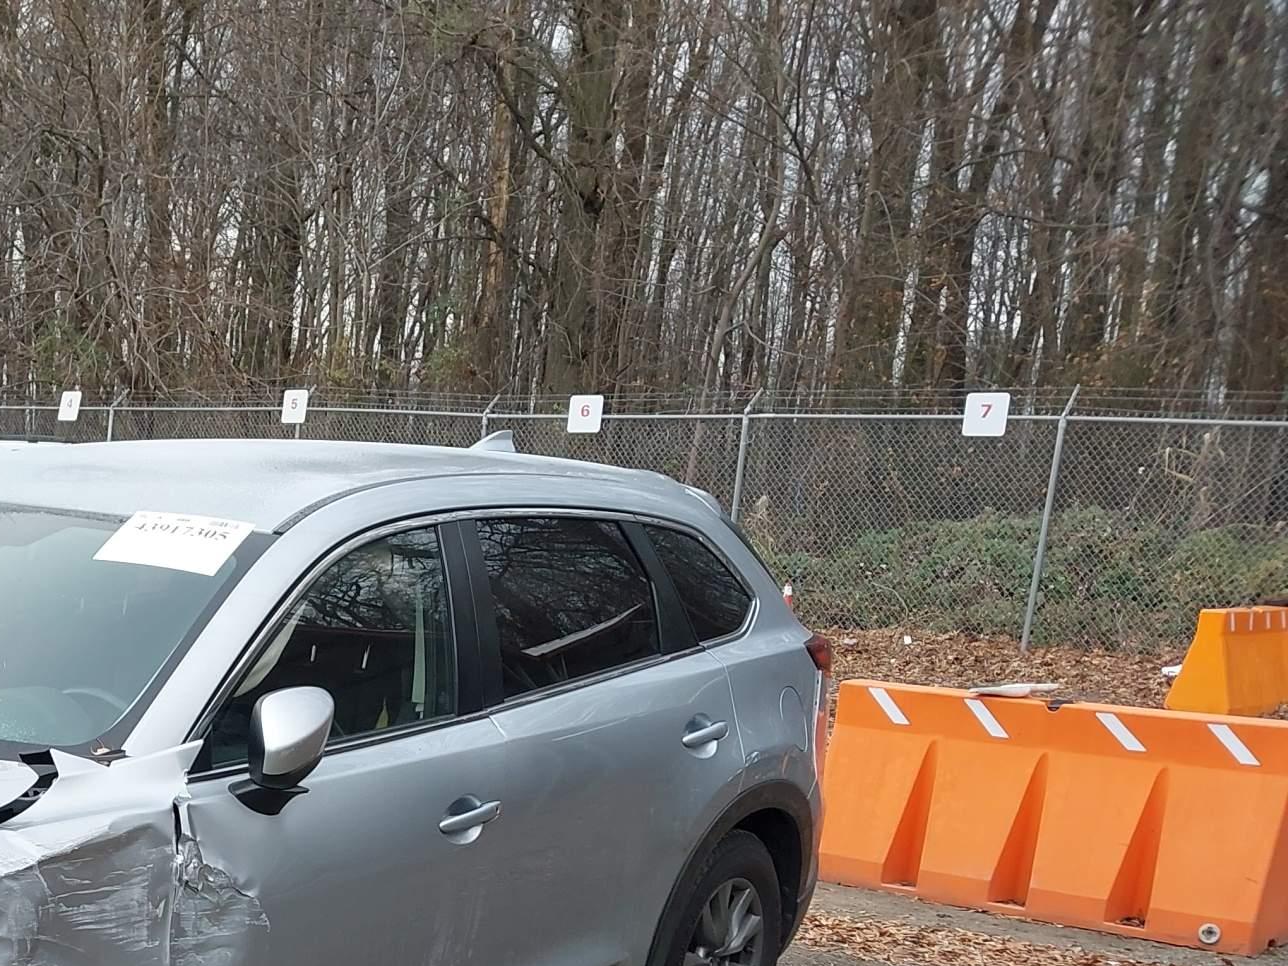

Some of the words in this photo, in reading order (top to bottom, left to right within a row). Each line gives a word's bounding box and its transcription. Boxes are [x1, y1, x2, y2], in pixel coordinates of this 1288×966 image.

[66, 397, 74, 409] 4
[290, 398, 299, 410] 5
[580, 404, 591, 418] 6
[980, 403, 993, 419] 7
